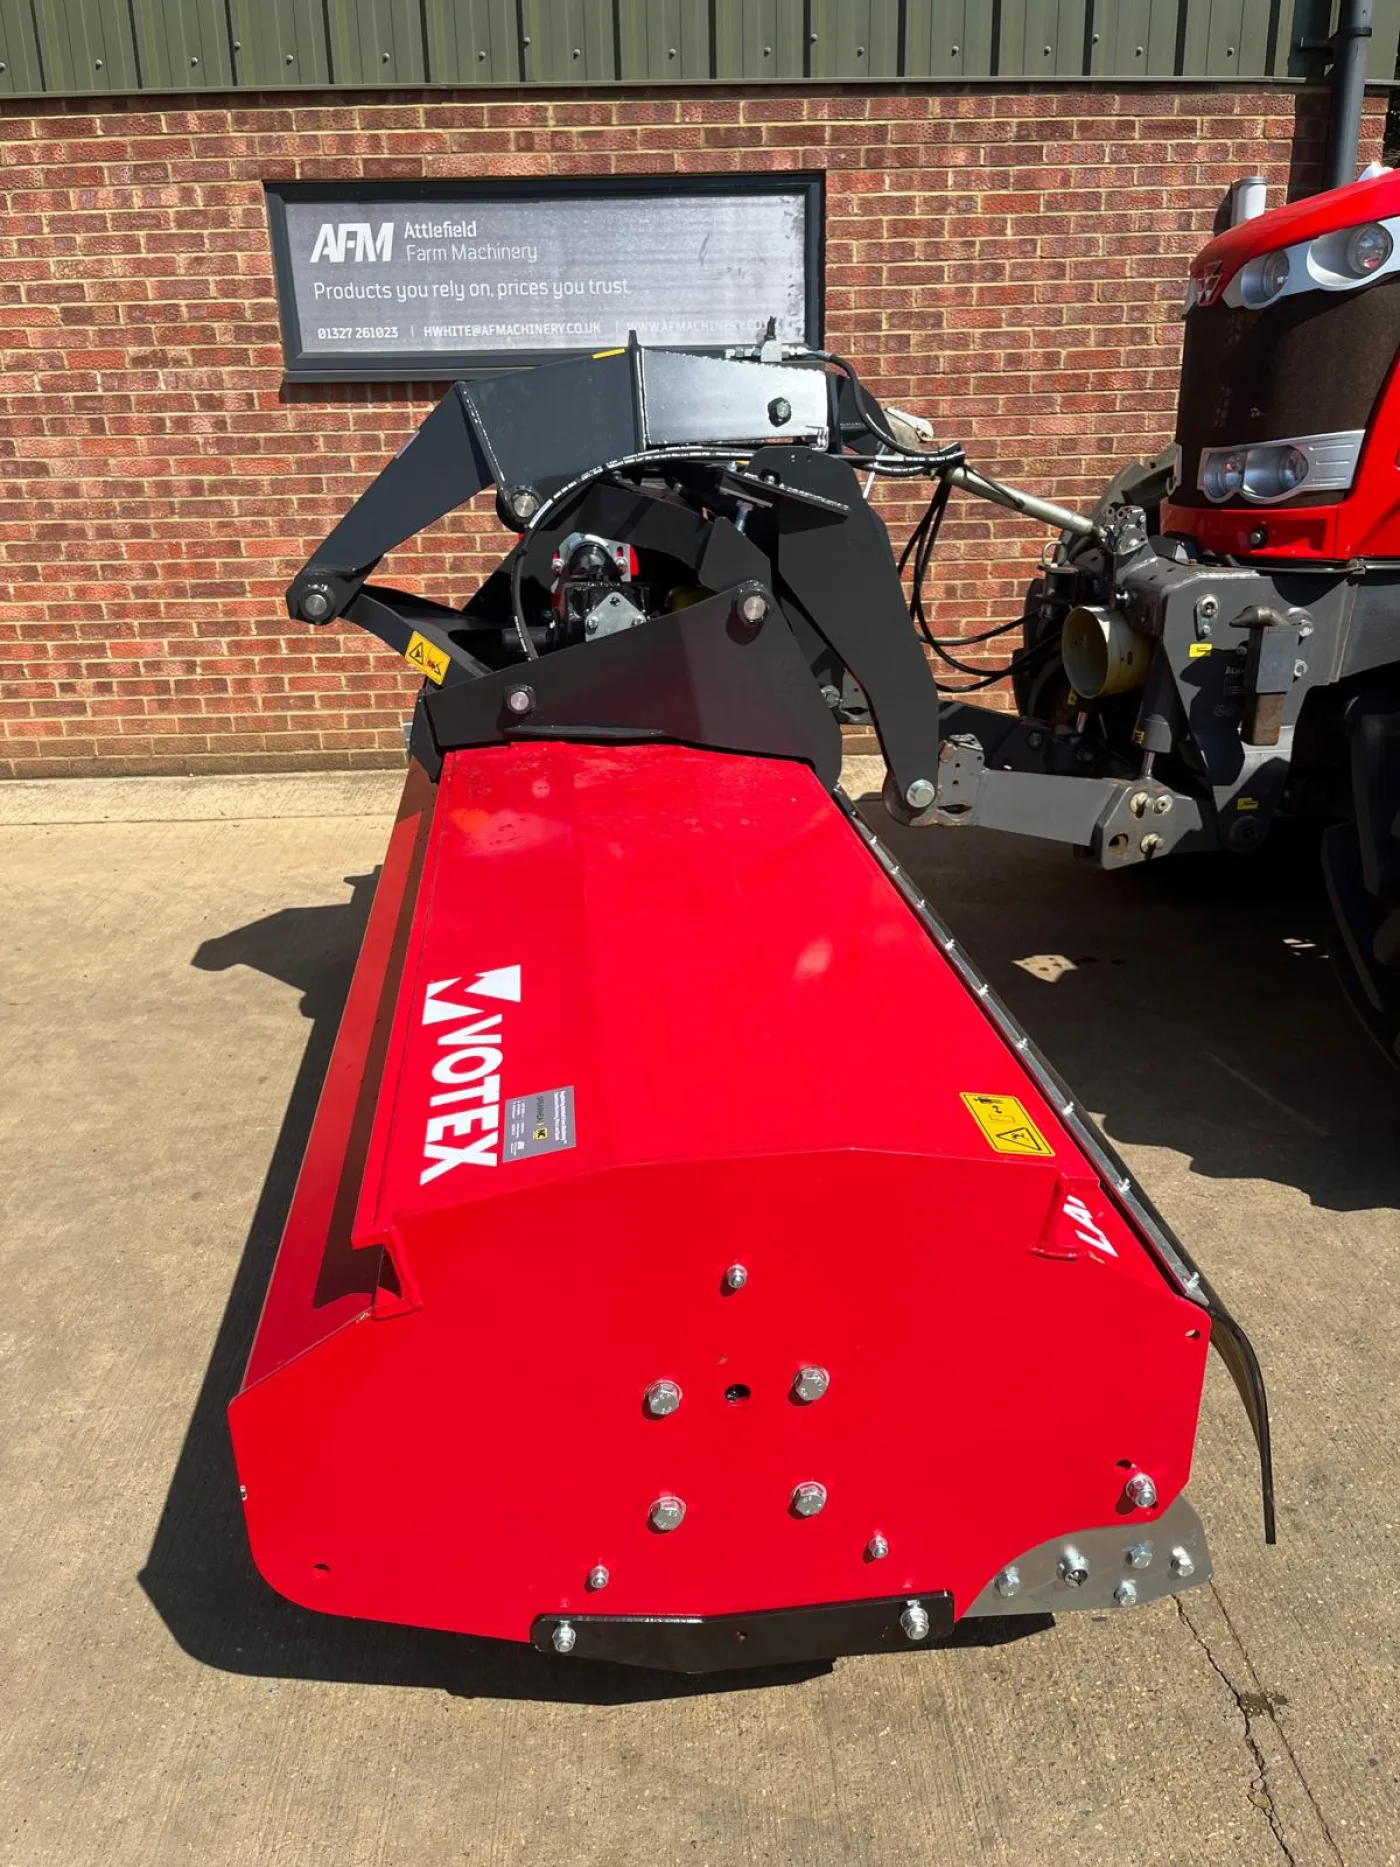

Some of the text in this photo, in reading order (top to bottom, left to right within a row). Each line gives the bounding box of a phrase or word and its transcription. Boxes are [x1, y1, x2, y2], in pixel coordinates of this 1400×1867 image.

[404, 220, 477, 239] Attlefield
[310, 222, 394, 263] AFM
[406, 243, 538, 263] Farm Machinery
[313, 282, 392, 300] Products
[397, 285, 428, 302] you
[432, 281, 465, 301] rely
[497, 280, 549, 300] prices
[553, 282, 585, 299] you
[317, 327, 353, 339] 01327
[355, 326, 398, 338] 261023
[420, 1013, 504, 1186] VOTEX
